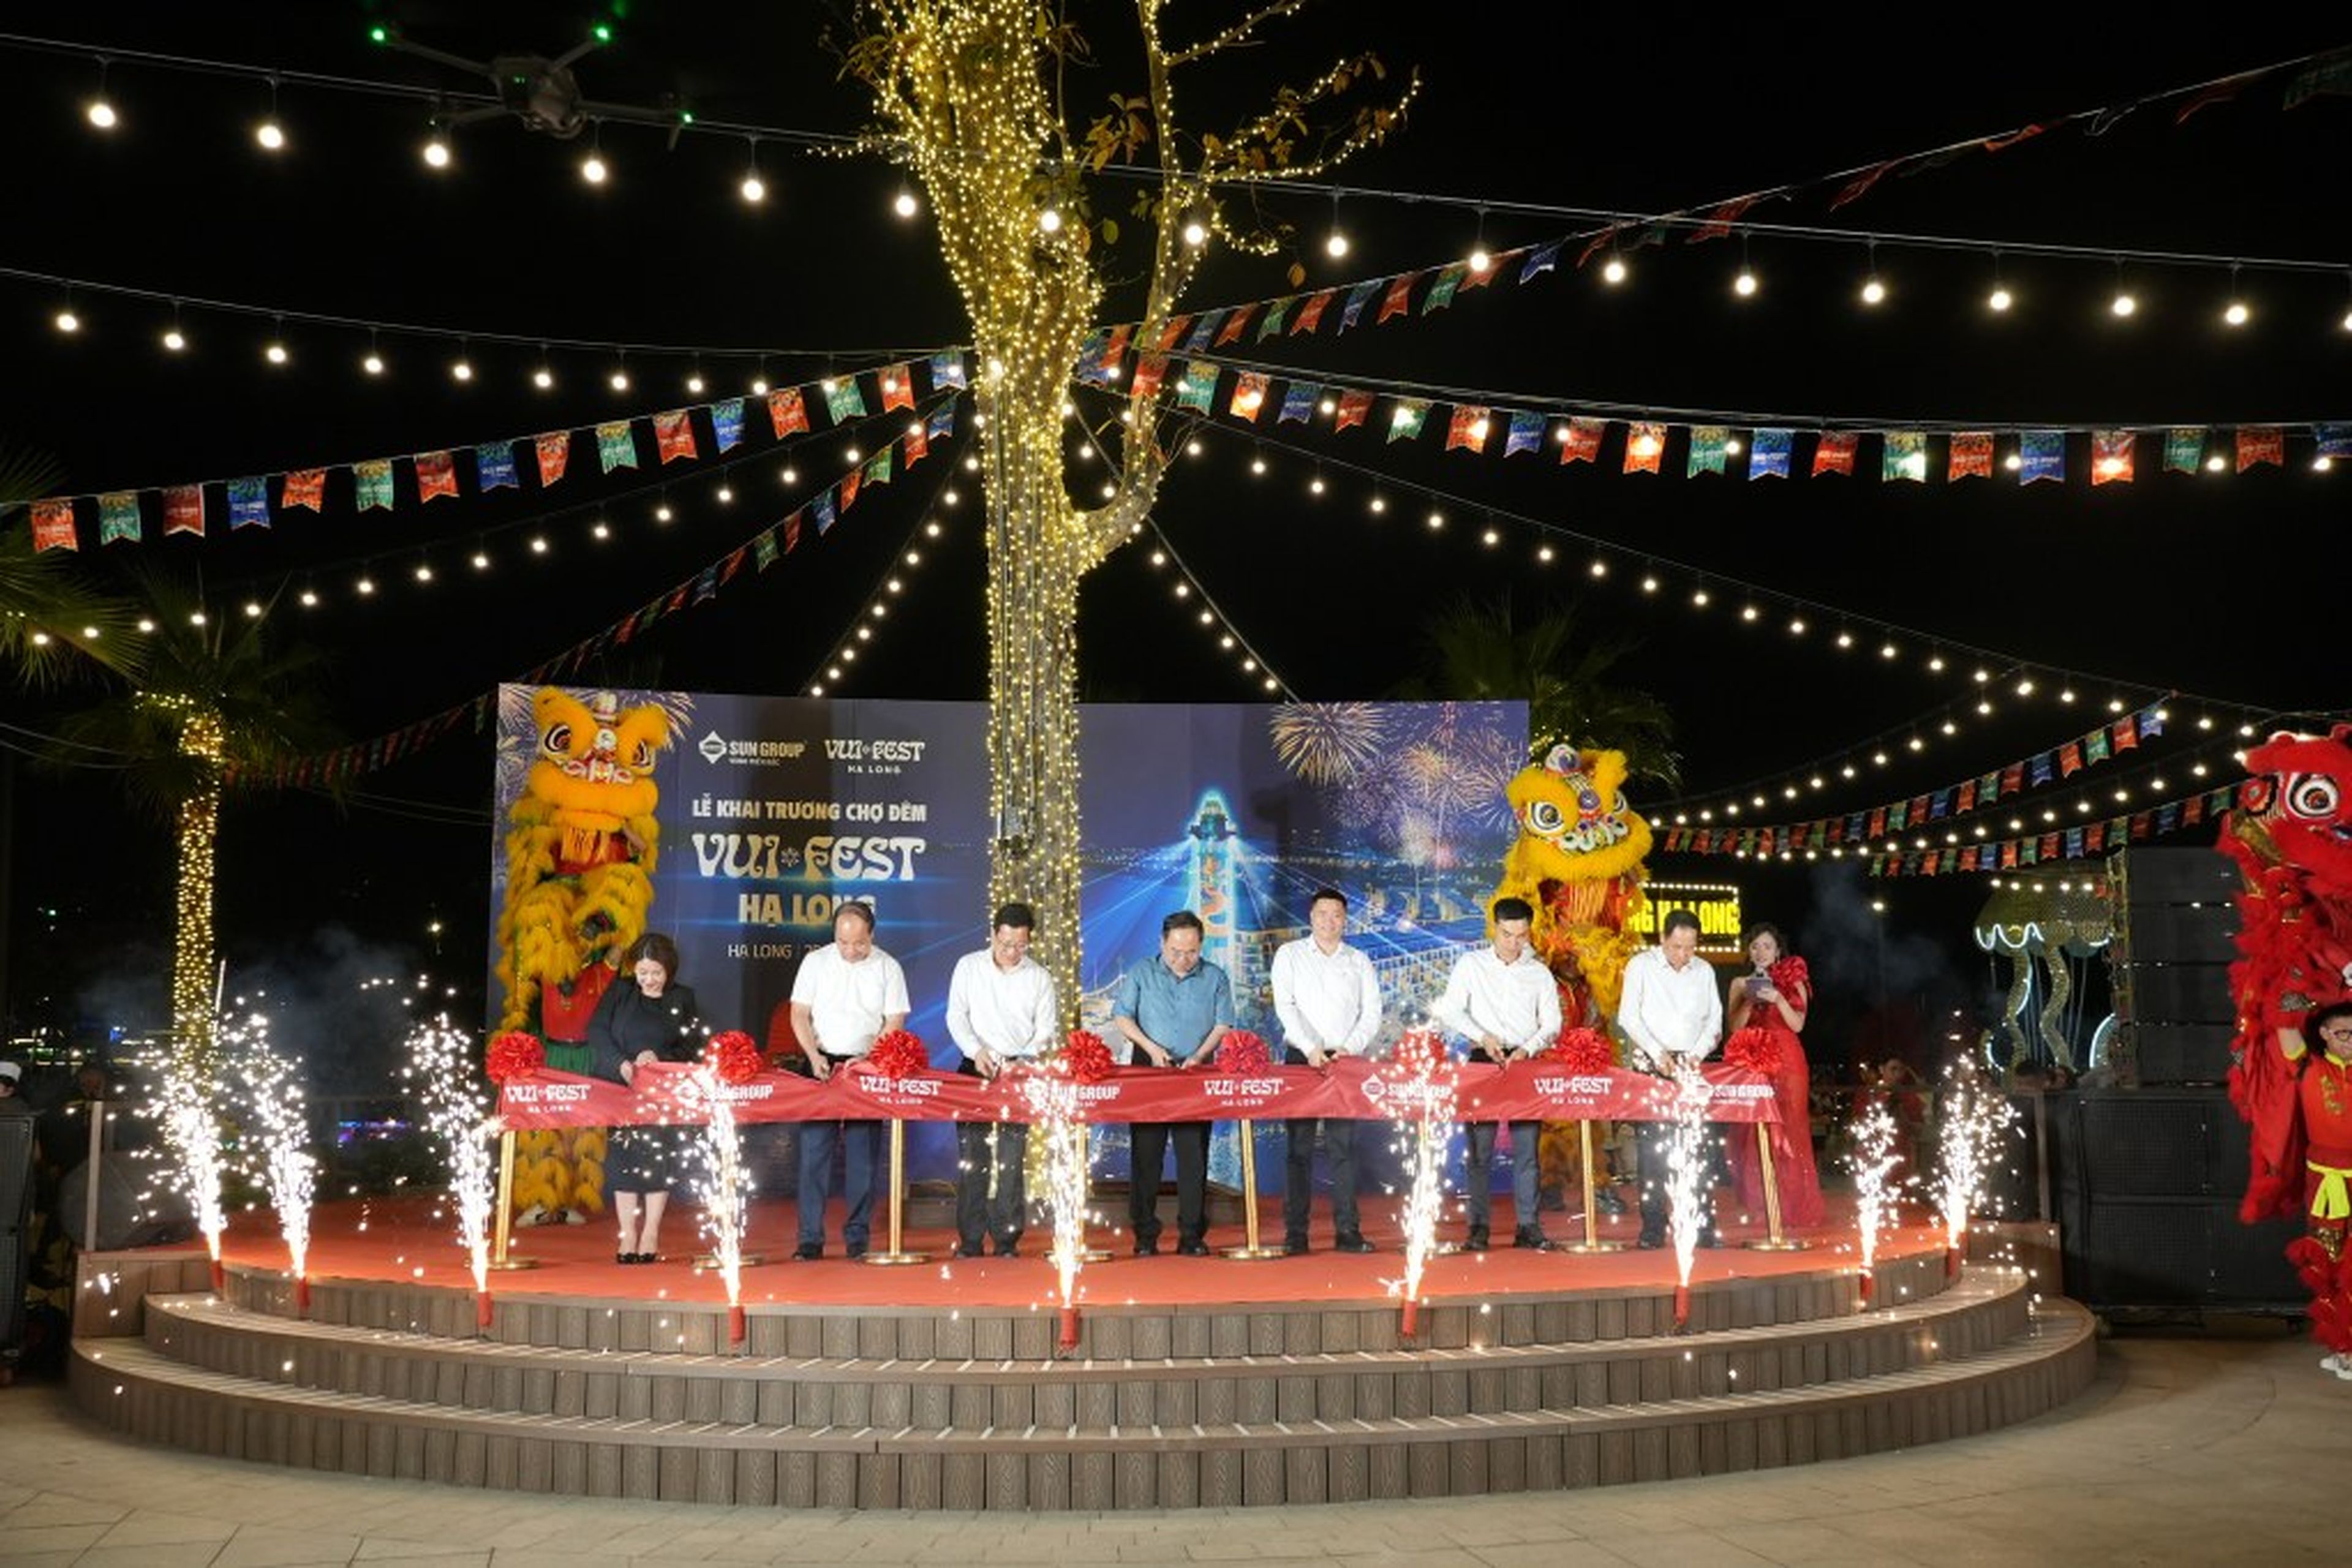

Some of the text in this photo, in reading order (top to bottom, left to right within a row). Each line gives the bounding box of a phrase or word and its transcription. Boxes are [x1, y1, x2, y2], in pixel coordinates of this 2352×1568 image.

[729, 741, 805, 758] SUN GROUP
[824, 739, 925, 761] VUI FEST
[717, 799, 760, 819] KHAI
[845, 802, 884, 823] CHỢ
[692, 833, 926, 881] VUI FEST
[739, 893, 783, 927] HẠ
[753, 944, 792, 959] LONG
[546, 1084, 591, 1101] FEST
[898, 1078, 943, 1096] FEST
[1240, 1077, 1284, 1095] FEST
[1571, 1075, 1613, 1095] FEST
